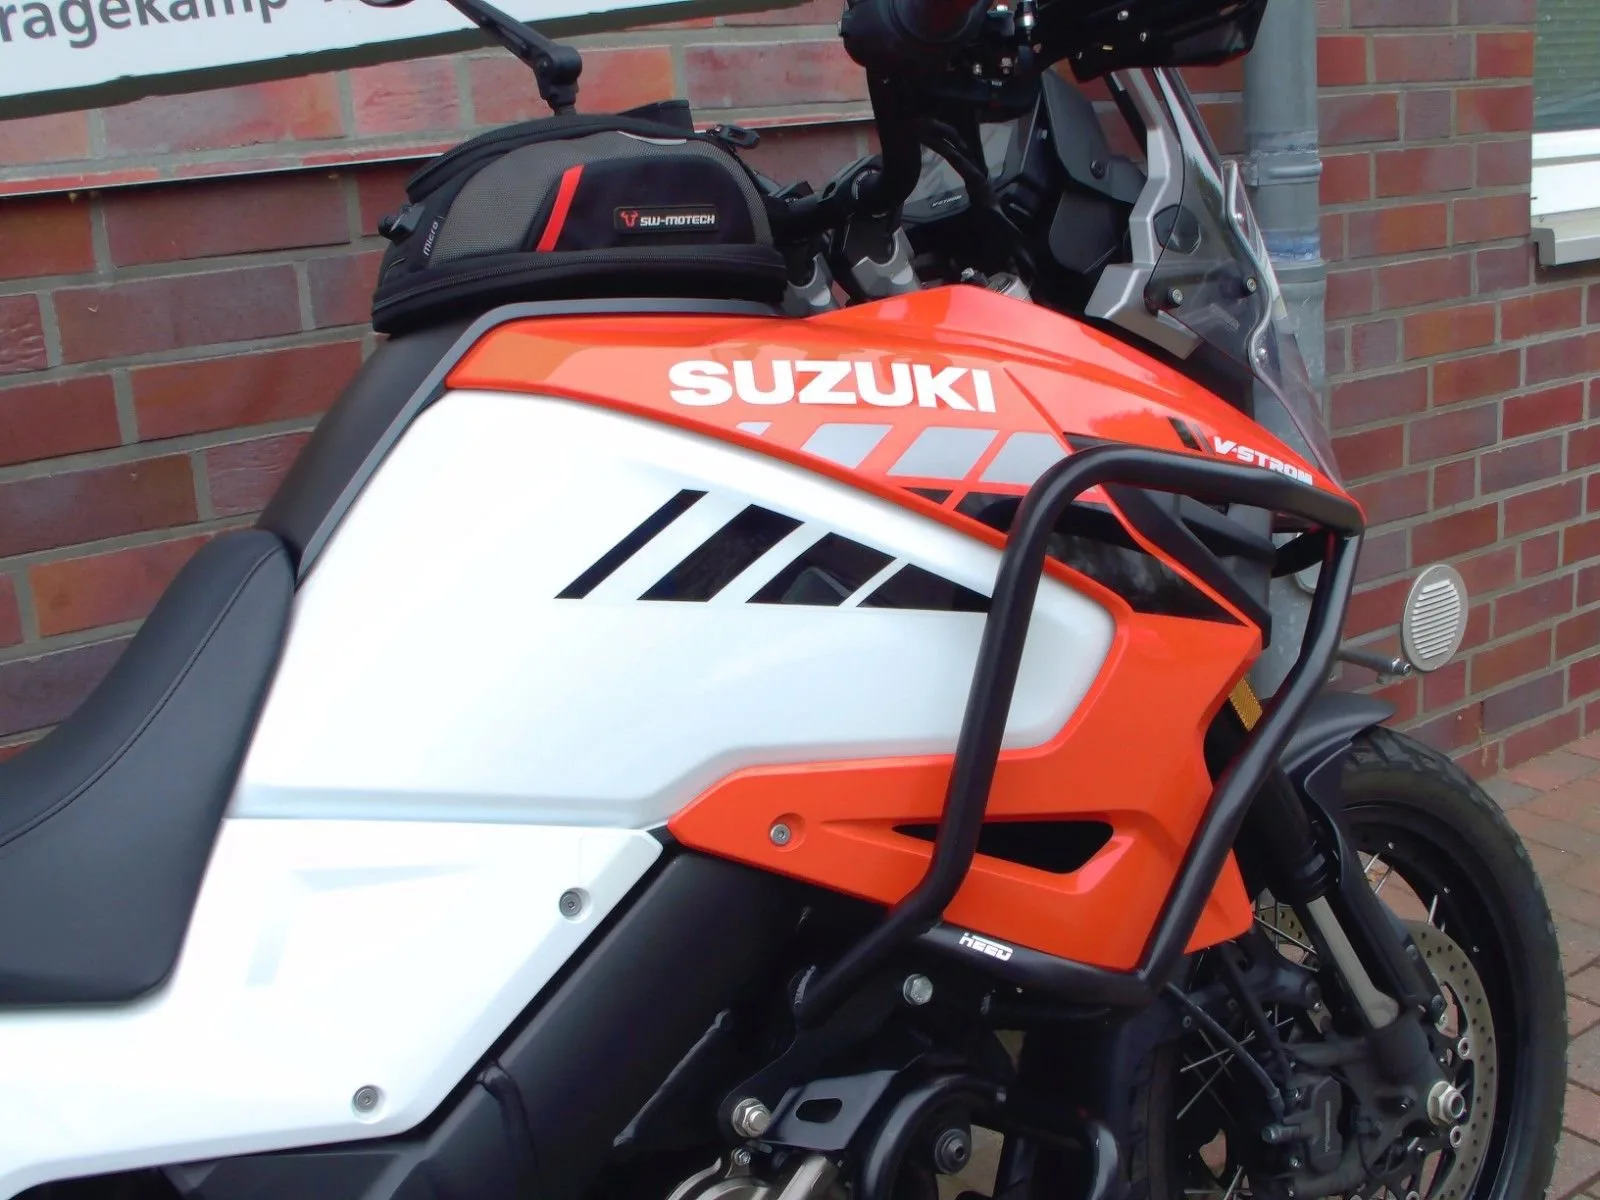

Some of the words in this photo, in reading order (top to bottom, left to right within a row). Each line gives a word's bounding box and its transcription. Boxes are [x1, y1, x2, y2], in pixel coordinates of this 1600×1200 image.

[423, 220, 439, 256] micro
[640, 214, 715, 227] SW-MOTECH
[668, 359, 996, 413] SUZUKI
[1213, 436, 1313, 486] V-STROM
